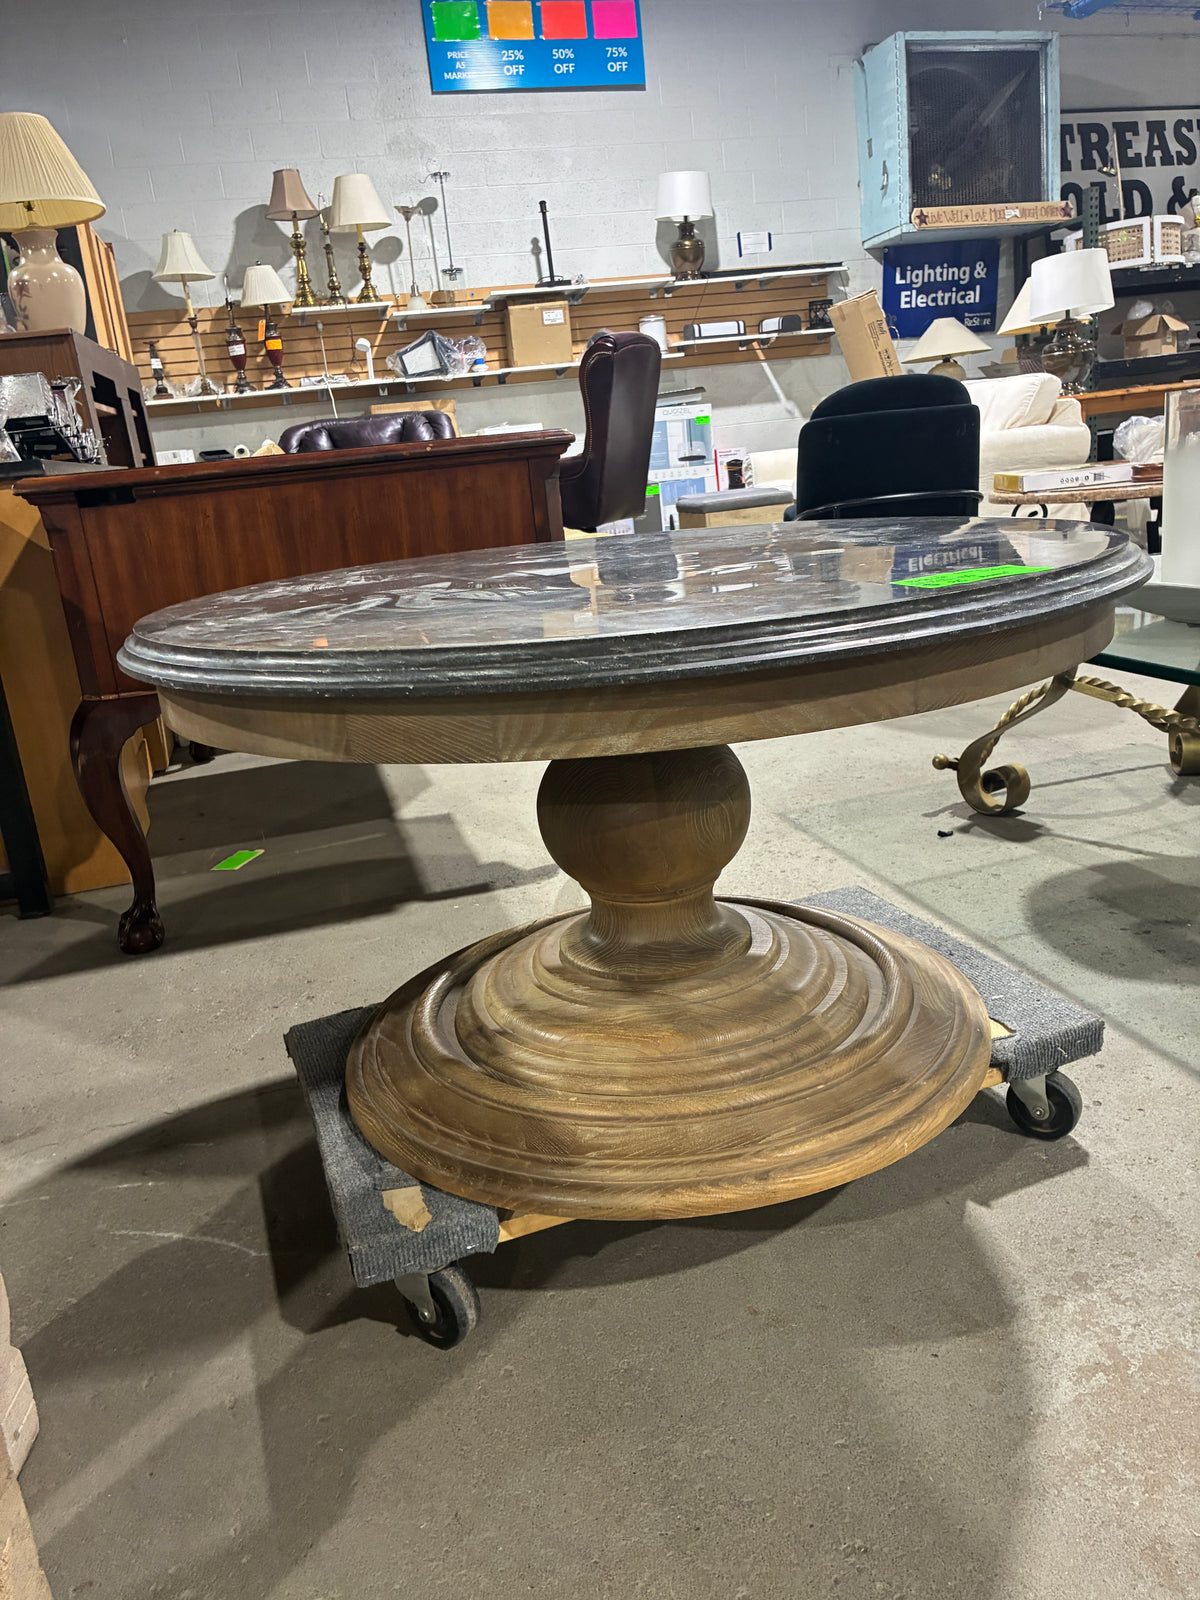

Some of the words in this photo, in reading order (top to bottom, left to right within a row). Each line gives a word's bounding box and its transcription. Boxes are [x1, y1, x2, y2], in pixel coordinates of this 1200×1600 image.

[502, 50, 525, 61] 25%
[552, 48, 575, 60] 50%
[605, 47, 628, 58] 75%
[455, 61, 466, 70] AS
[503, 65, 525, 76] OFF
[553, 63, 576, 74] OFF
[607, 61, 628, 73] OFF
[1060, 118, 1200, 172] TREAS
[895, 263, 970, 288] Lighting
[973, 261, 988, 279] &
[900, 284, 981, 309] Electrical
